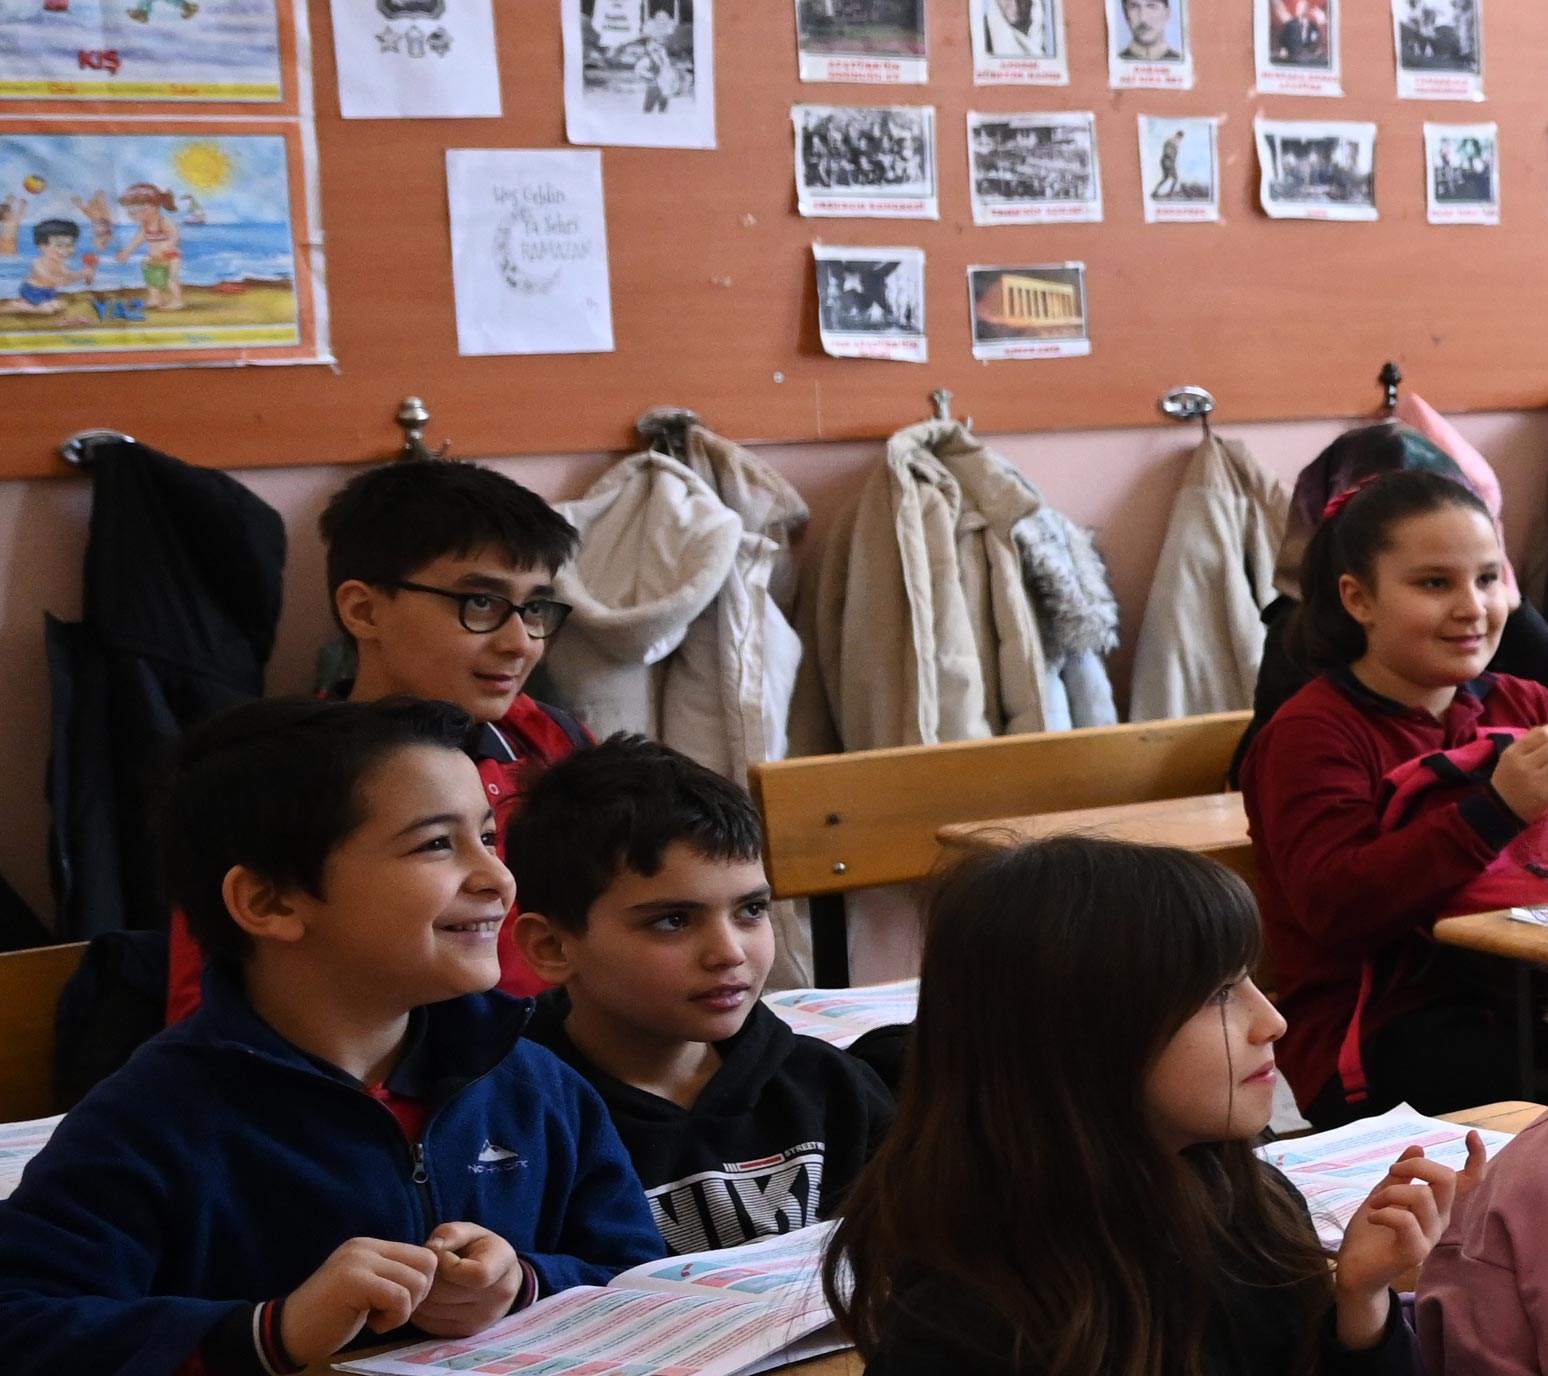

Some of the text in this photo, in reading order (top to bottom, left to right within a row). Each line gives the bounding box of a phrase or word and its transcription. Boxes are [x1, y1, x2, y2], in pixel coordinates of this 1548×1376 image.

[77, 48, 122, 75] KIŞ
[92, 297, 146, 321] YAZ
[784, 1141, 816, 1157] STREET
